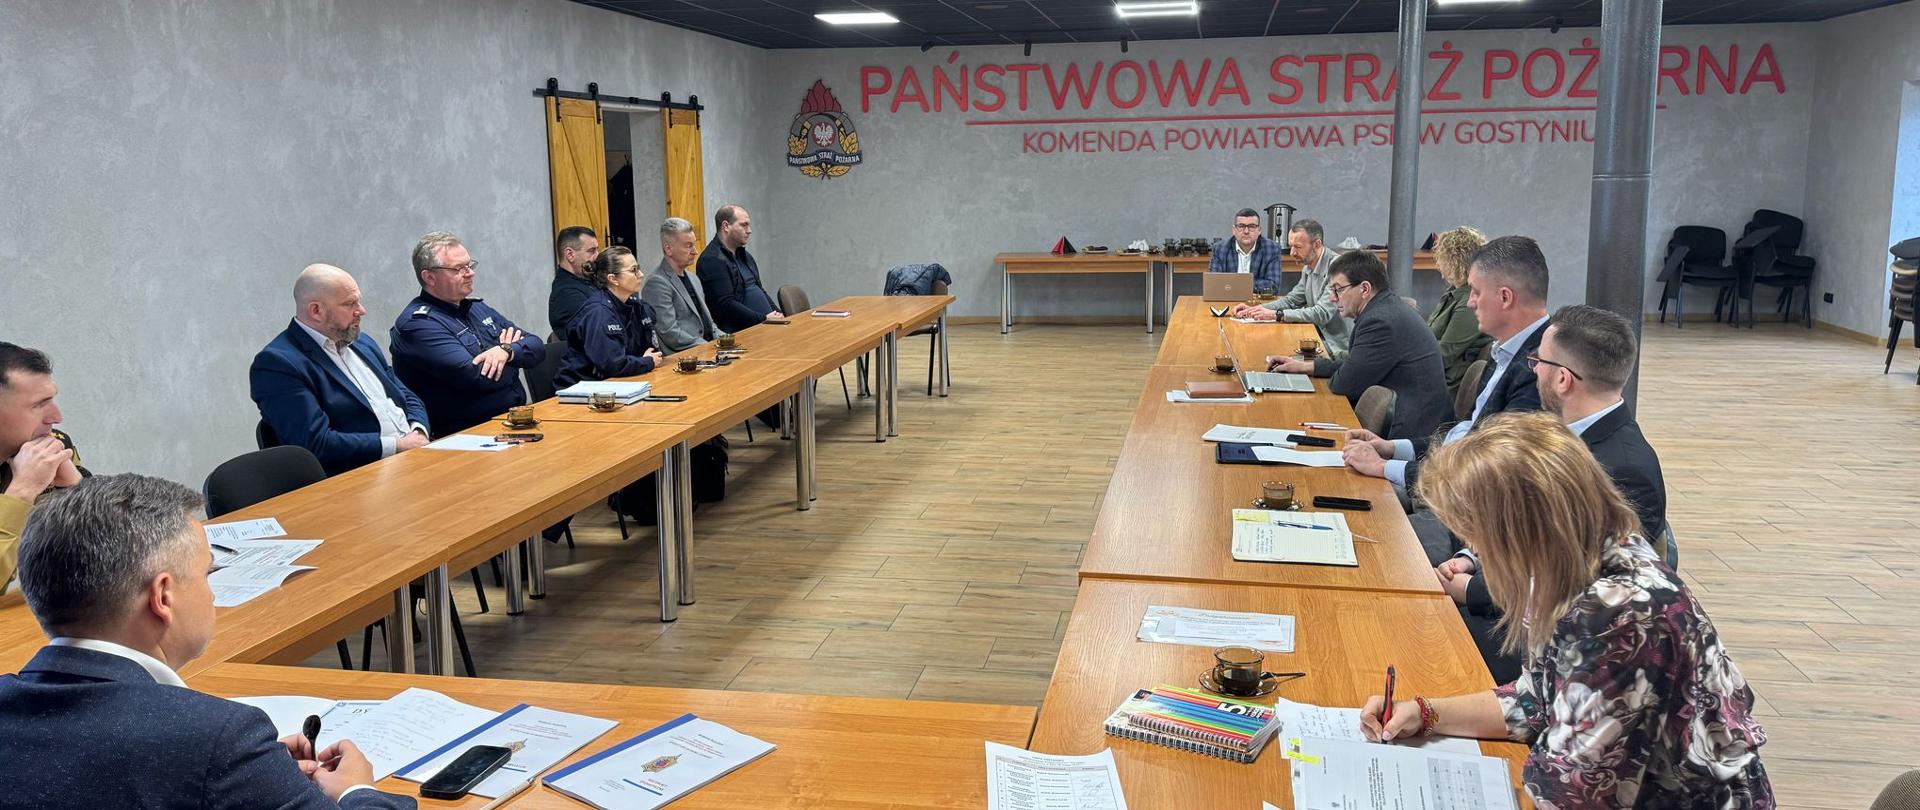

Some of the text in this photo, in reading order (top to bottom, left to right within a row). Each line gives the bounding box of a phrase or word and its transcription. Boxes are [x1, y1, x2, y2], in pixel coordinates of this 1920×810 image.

[860, 51, 1251, 113] PAŃSTWOWA
[1482, 37, 1787, 99] POŻRNA
[1022, 130, 1157, 154] KOMENDA
[1164, 124, 1345, 151] POWIATOWA
[1353, 122, 1395, 146] PS
[1454, 118, 1597, 145] GOSTYNIU
